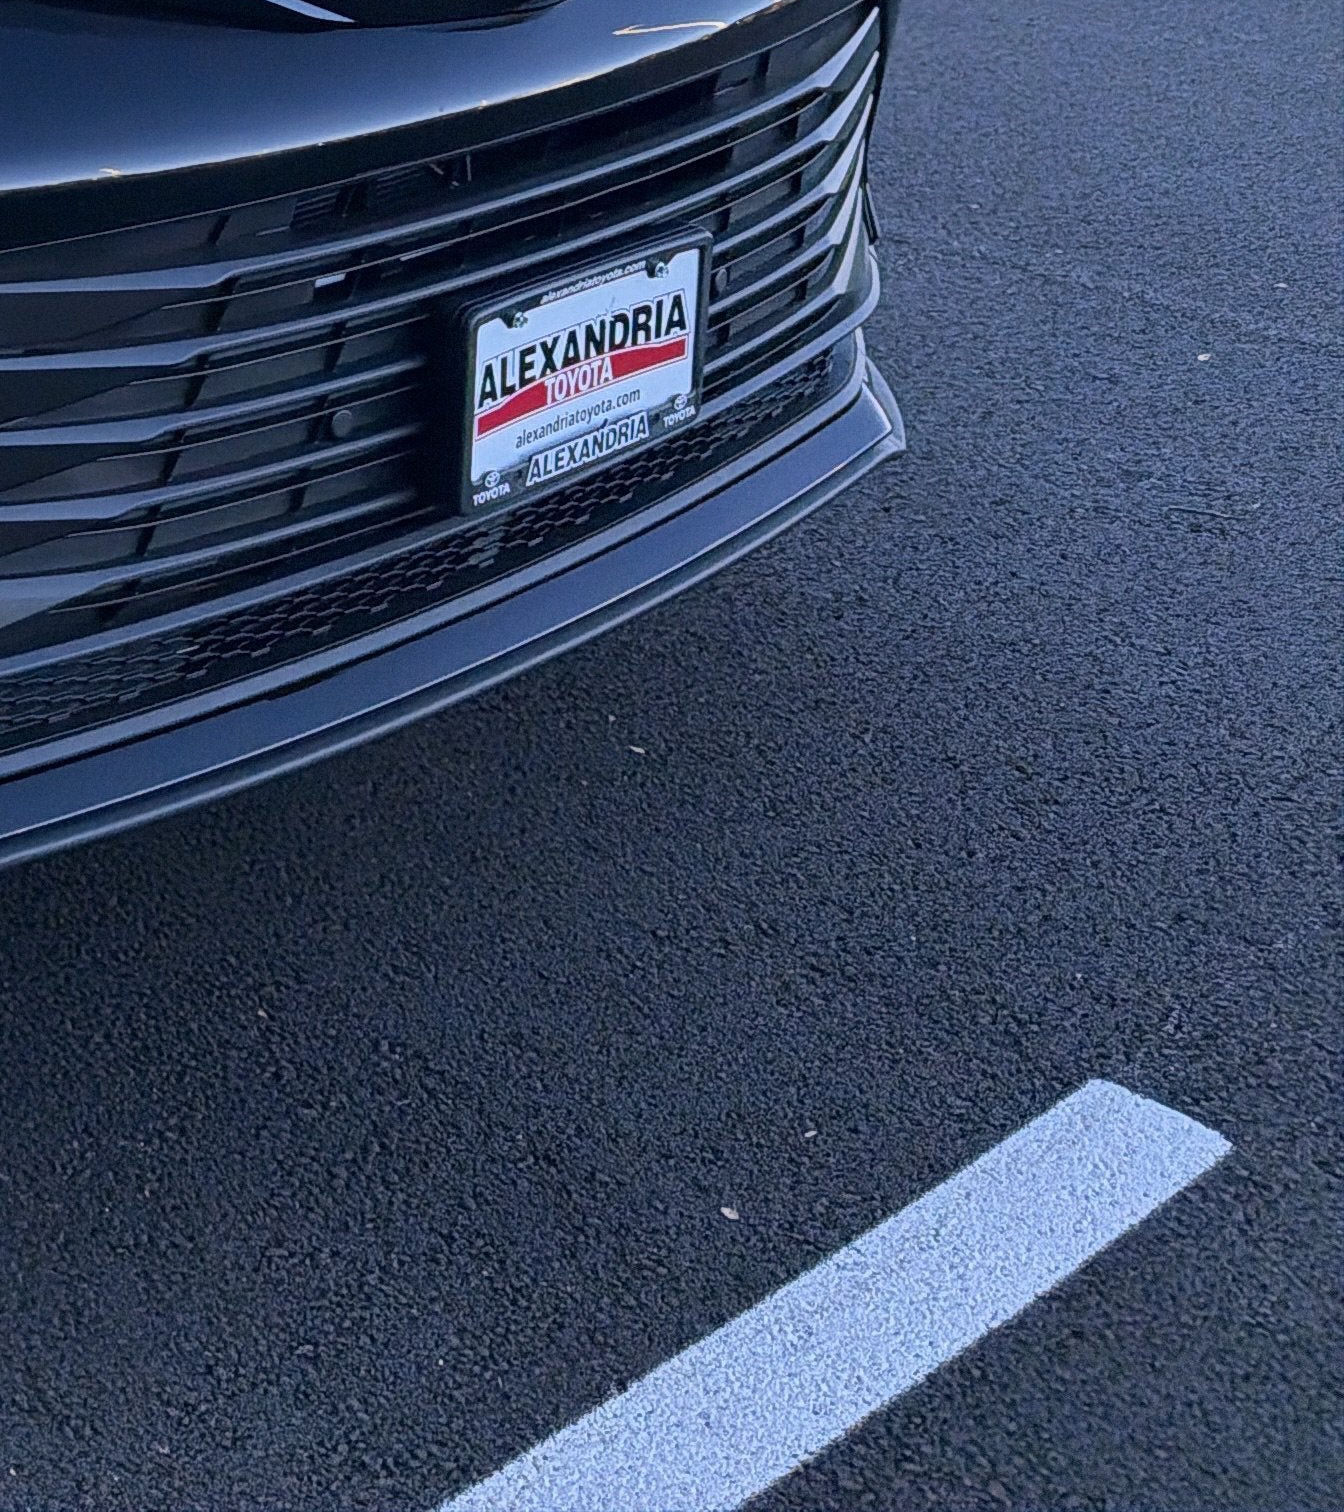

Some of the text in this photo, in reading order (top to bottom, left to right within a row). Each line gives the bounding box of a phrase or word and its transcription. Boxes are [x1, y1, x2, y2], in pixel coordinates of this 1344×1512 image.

[478, 293, 687, 409] ALEXANDRIA
[544, 357, 613, 406] TOYOTA
[515, 388, 641, 449] alexandriatoyota.com
[663, 405, 696, 428] TOYOTA
[529, 413, 648, 482] ALEXANDRIA
[473, 483, 511, 506] TOYOTA
